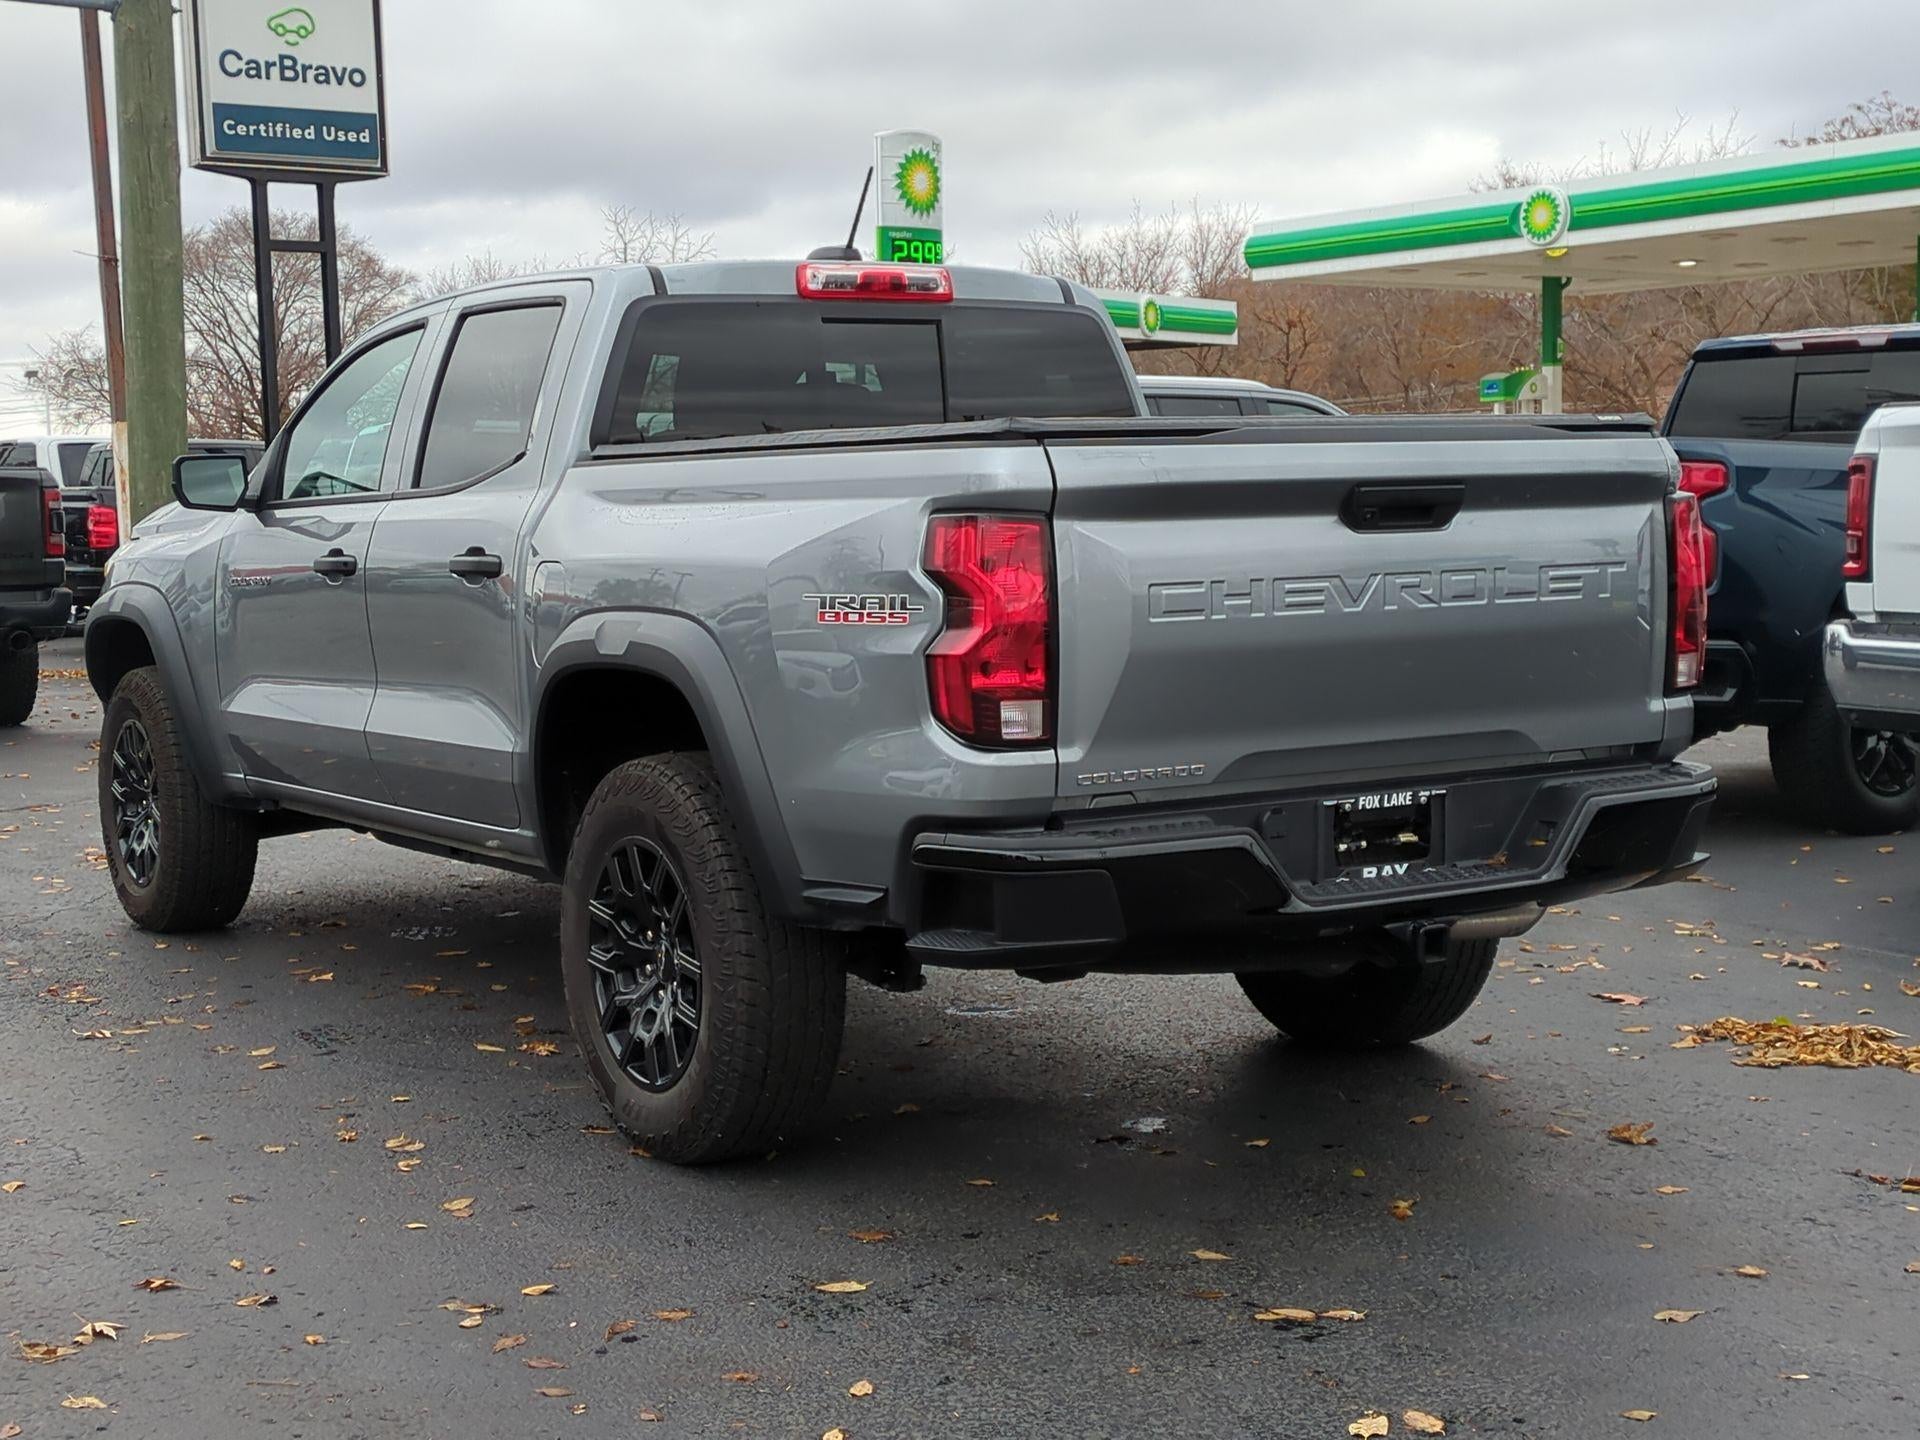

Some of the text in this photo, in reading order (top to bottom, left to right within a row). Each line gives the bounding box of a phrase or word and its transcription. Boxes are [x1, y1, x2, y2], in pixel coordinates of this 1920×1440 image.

[219, 49, 366, 87] CarBravo
[222, 119, 370, 143] Certified Used
[1148, 561, 1627, 622] CHEVROLET
[802, 593, 924, 612] TRAIL
[817, 610, 909, 625] BOSS
[1077, 764, 1205, 785] COLORADO
[1358, 791, 1413, 810] FOX LAKE
